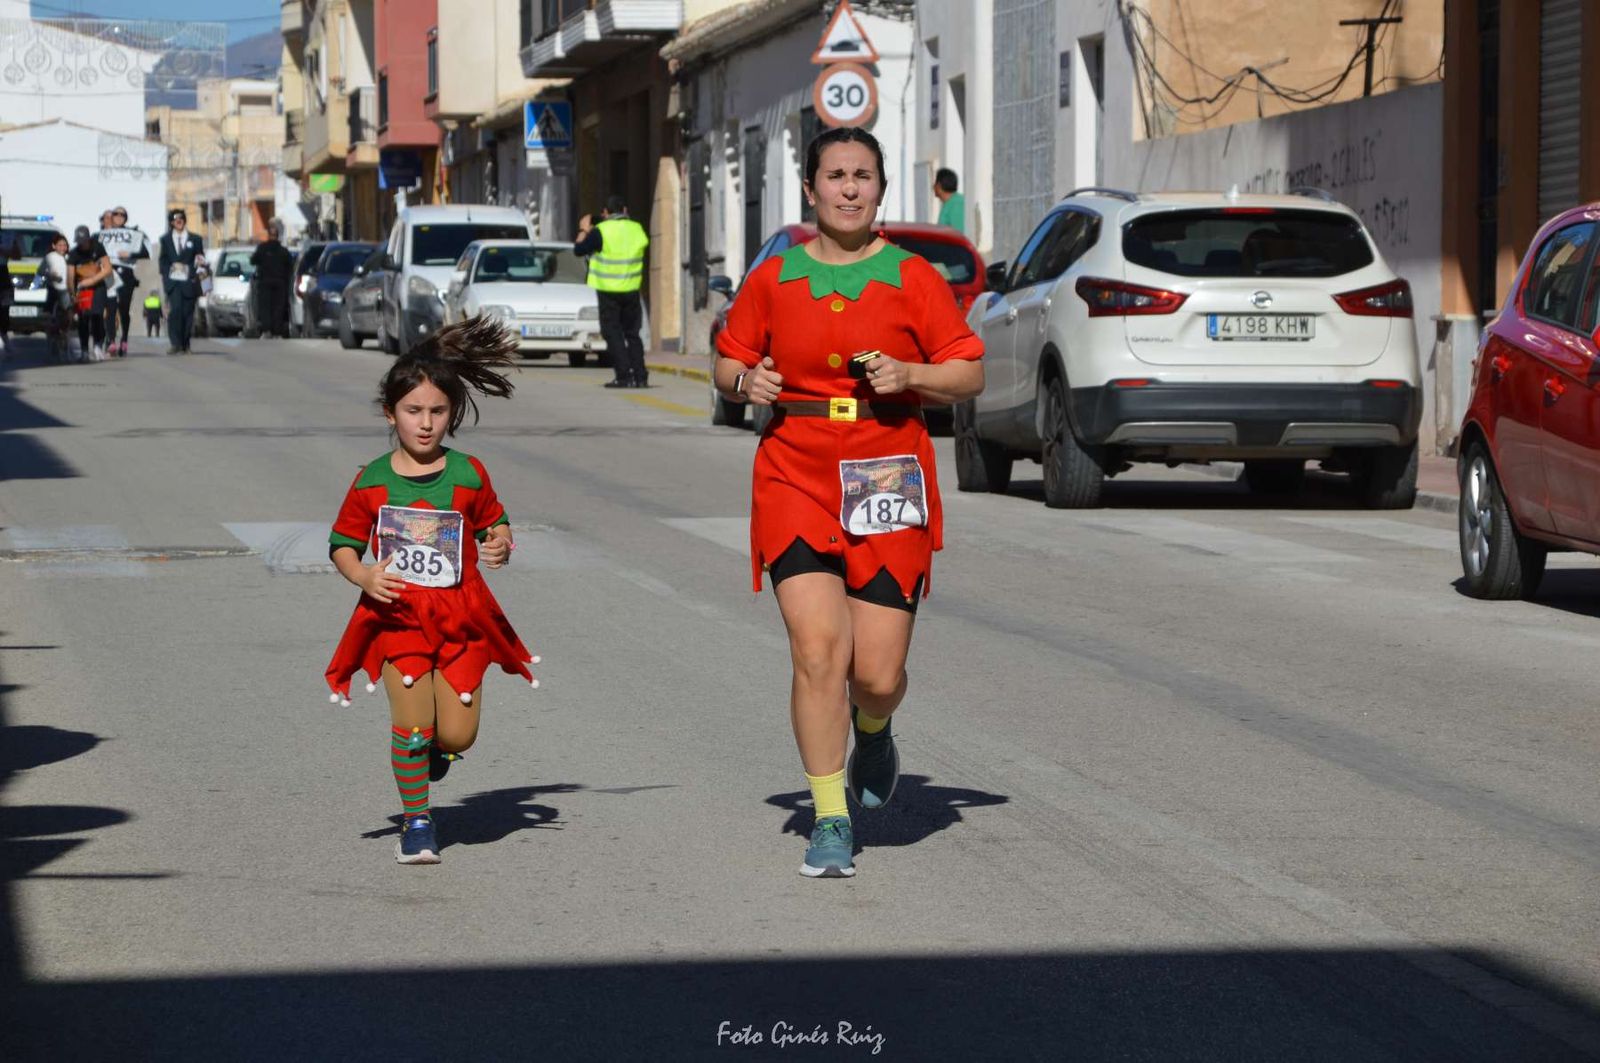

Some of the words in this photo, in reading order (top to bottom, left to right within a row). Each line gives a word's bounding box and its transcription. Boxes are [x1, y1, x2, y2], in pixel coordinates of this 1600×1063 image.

[827, 84, 864, 108] 30
[1222, 317, 1268, 334] 4198
[1275, 318, 1309, 334] KHW
[860, 498, 907, 524] 187
[395, 547, 443, 576] 385
